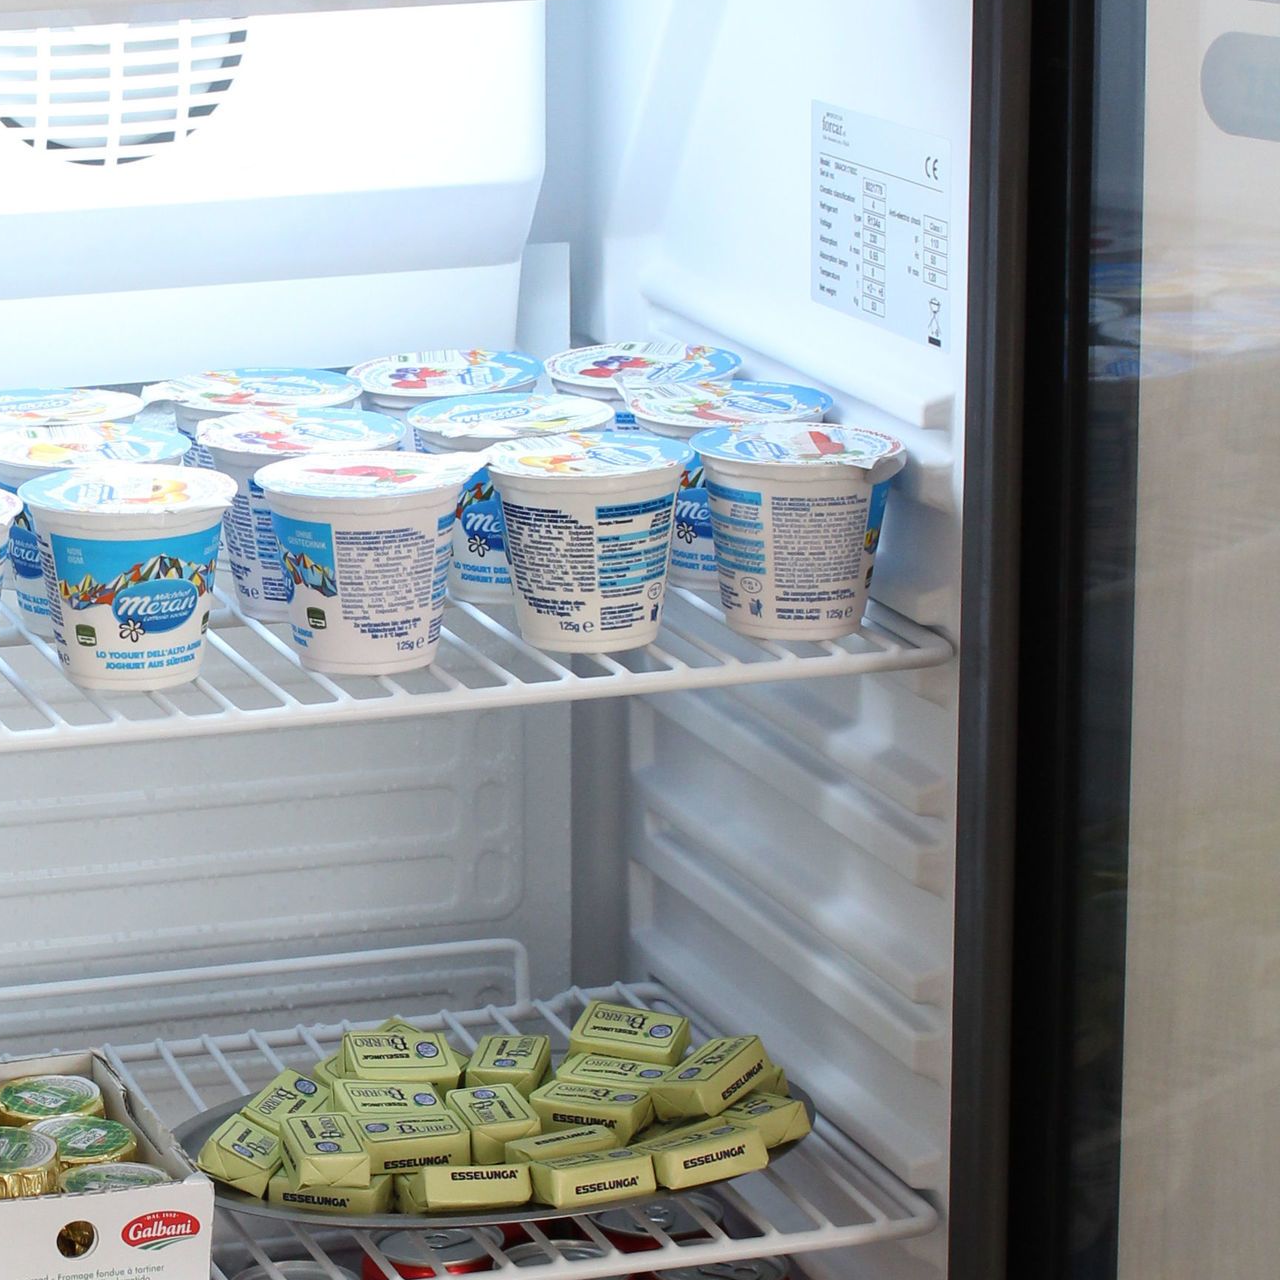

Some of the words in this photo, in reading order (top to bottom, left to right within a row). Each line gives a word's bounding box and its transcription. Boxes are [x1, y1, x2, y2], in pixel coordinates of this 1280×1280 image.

[152, 587, 192, 602] Milchhof
[117, 595, 196, 617] Meran
[826, 610, 842, 620] 125g
[559, 621, 580, 632] 125g
[396, 640, 414, 651] 125g
[96, 650, 107, 659] LO
[109, 651, 144, 660] YOGURT
[105, 660, 145, 670] JOGHURT
[147, 659, 164, 669] AUS
[594, 1008, 648, 1030] BURRO
[353, 1034, 410, 1052] BURRO
[721, 1063, 764, 1101] ESSELUNGA
[259, 1086, 298, 1115] BURRO
[351, 1087, 408, 1102] BURRO
[552, 1112, 616, 1130] ESSELUNGA
[535, 1128, 597, 1146] ESSELUNGA
[384, 1156, 449, 1170] ESSELUNGA
[683, 1146, 745, 1170] ESSELUNGA
[451, 1170, 517, 1181] ESSELUNGA
[575, 1178, 638, 1195] ESSELUNGA
[282, 1192, 347, 1208] ESSELUNGA
[128, 1219, 192, 1241] Galbani
[96, 1267, 125, 1278] fondue
[135, 1264, 165, 1274] tartiner
